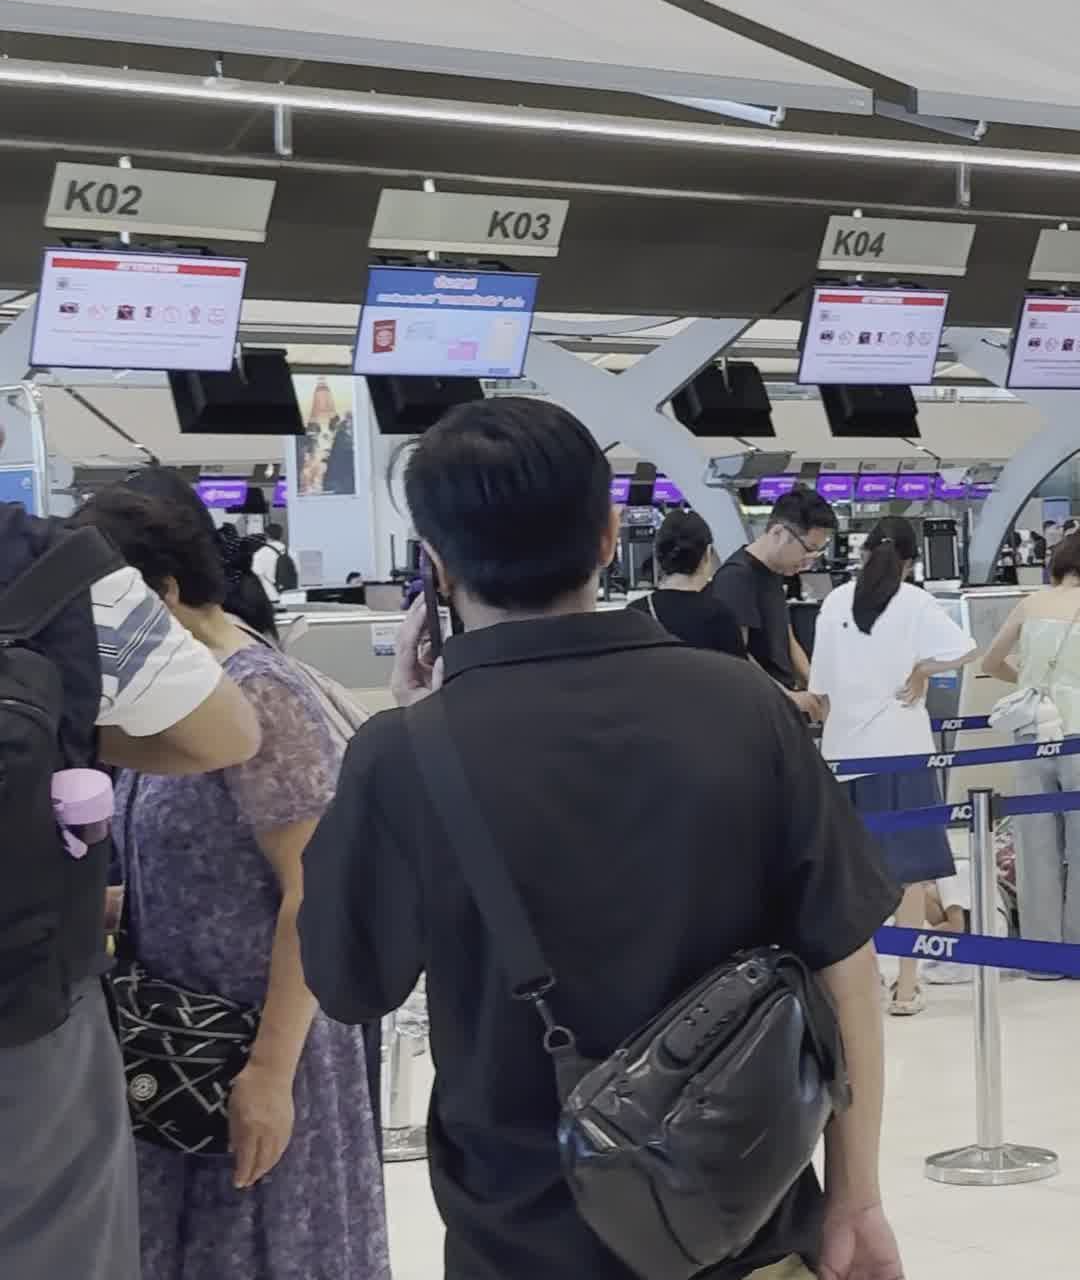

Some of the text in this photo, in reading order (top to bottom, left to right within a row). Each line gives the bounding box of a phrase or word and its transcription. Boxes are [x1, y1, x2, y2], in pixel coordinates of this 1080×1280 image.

[64, 180, 143, 215] K02
[487, 210, 551, 240] K03
[832, 229, 886, 258] K04
[941, 720, 965, 731] AOT
[927, 743, 1063, 767] AOT AOT
[912, 934, 959, 956] AOT
